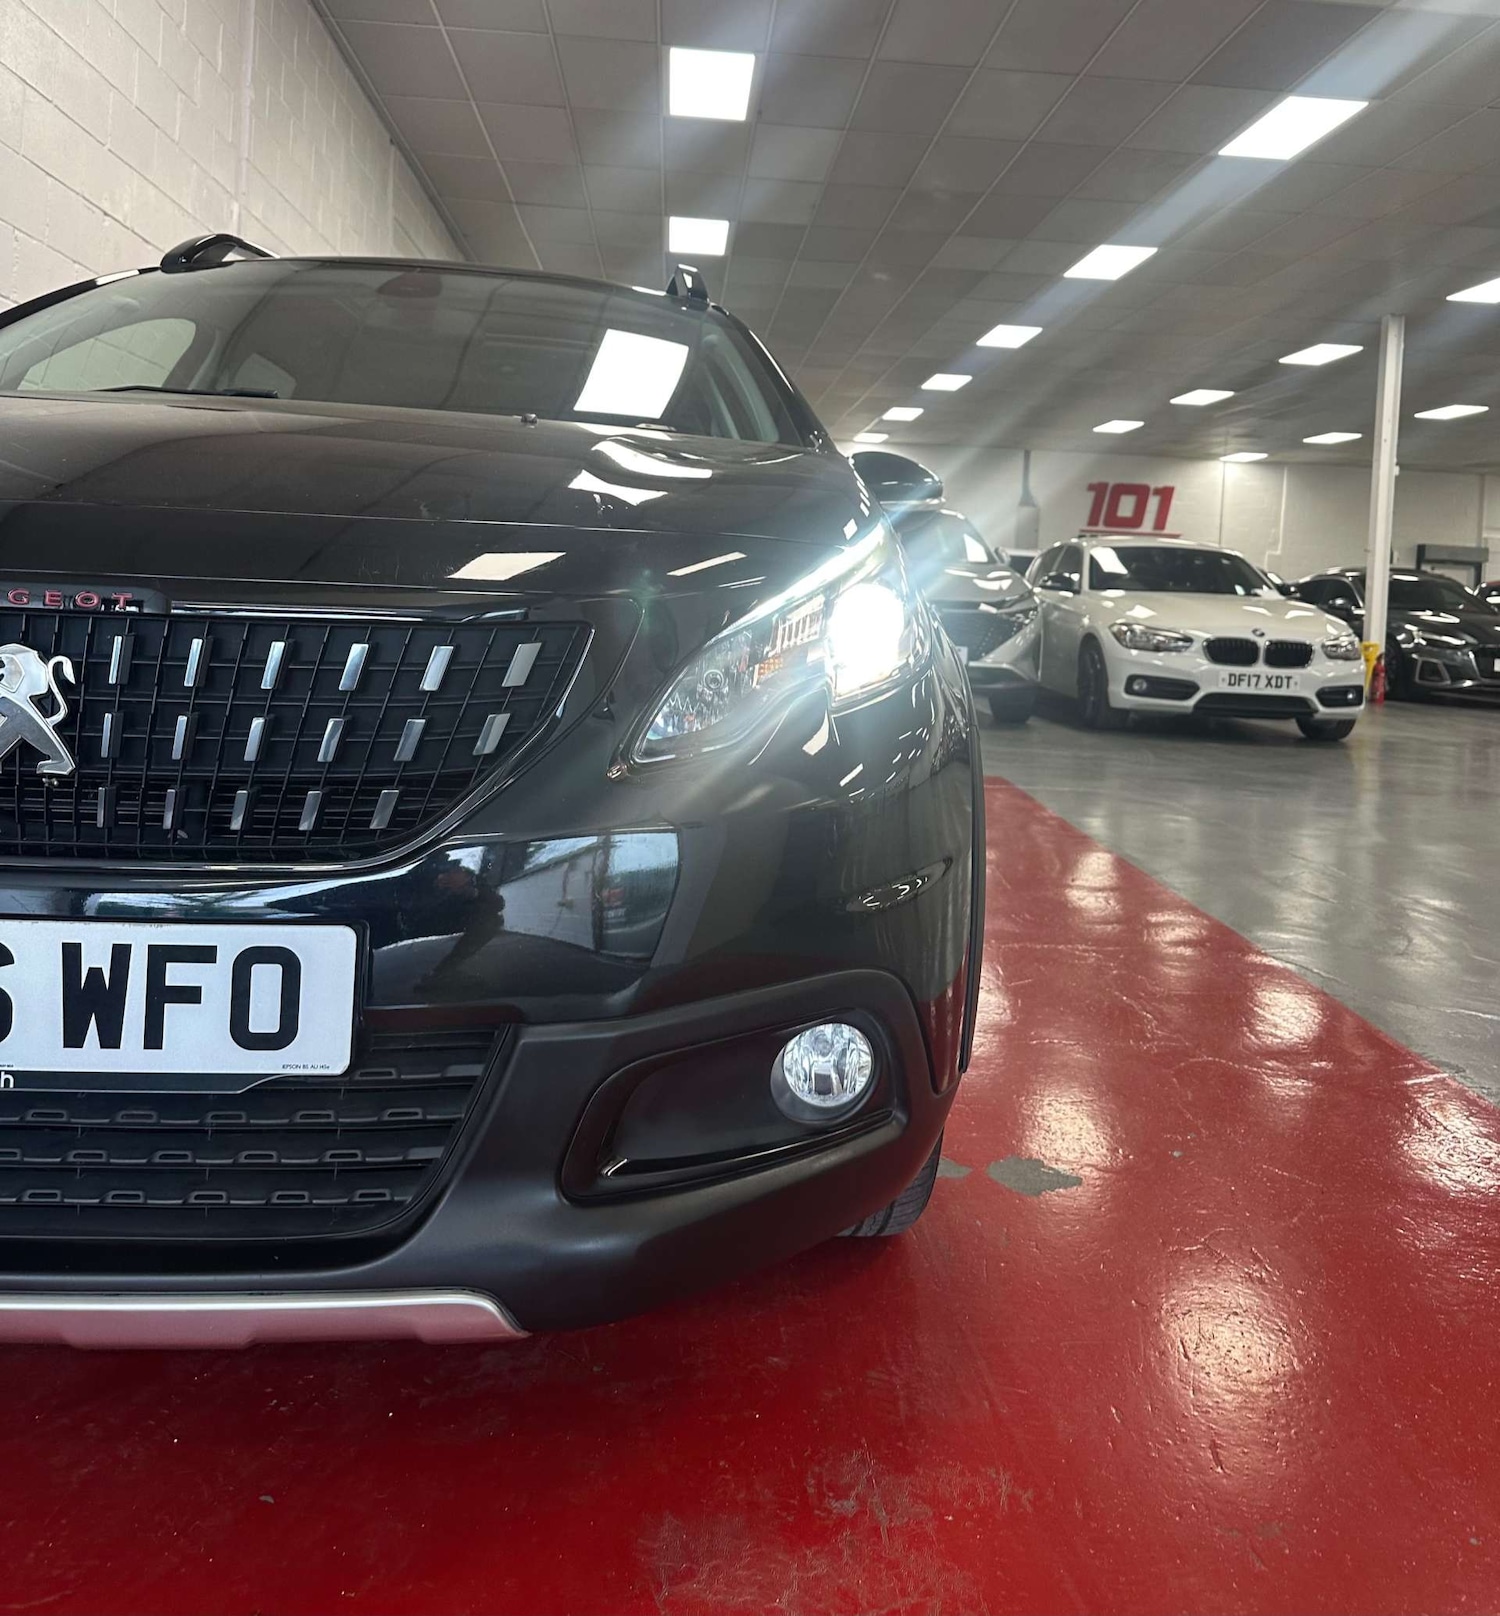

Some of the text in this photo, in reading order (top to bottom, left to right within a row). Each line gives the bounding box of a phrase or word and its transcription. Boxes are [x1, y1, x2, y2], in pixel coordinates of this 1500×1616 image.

[1086, 482, 1175, 531] 101
[7, 588, 133, 609] GEOT
[1227, 673, 1293, 690] DF17 XDT
[61, 942, 302, 1051] WFO
